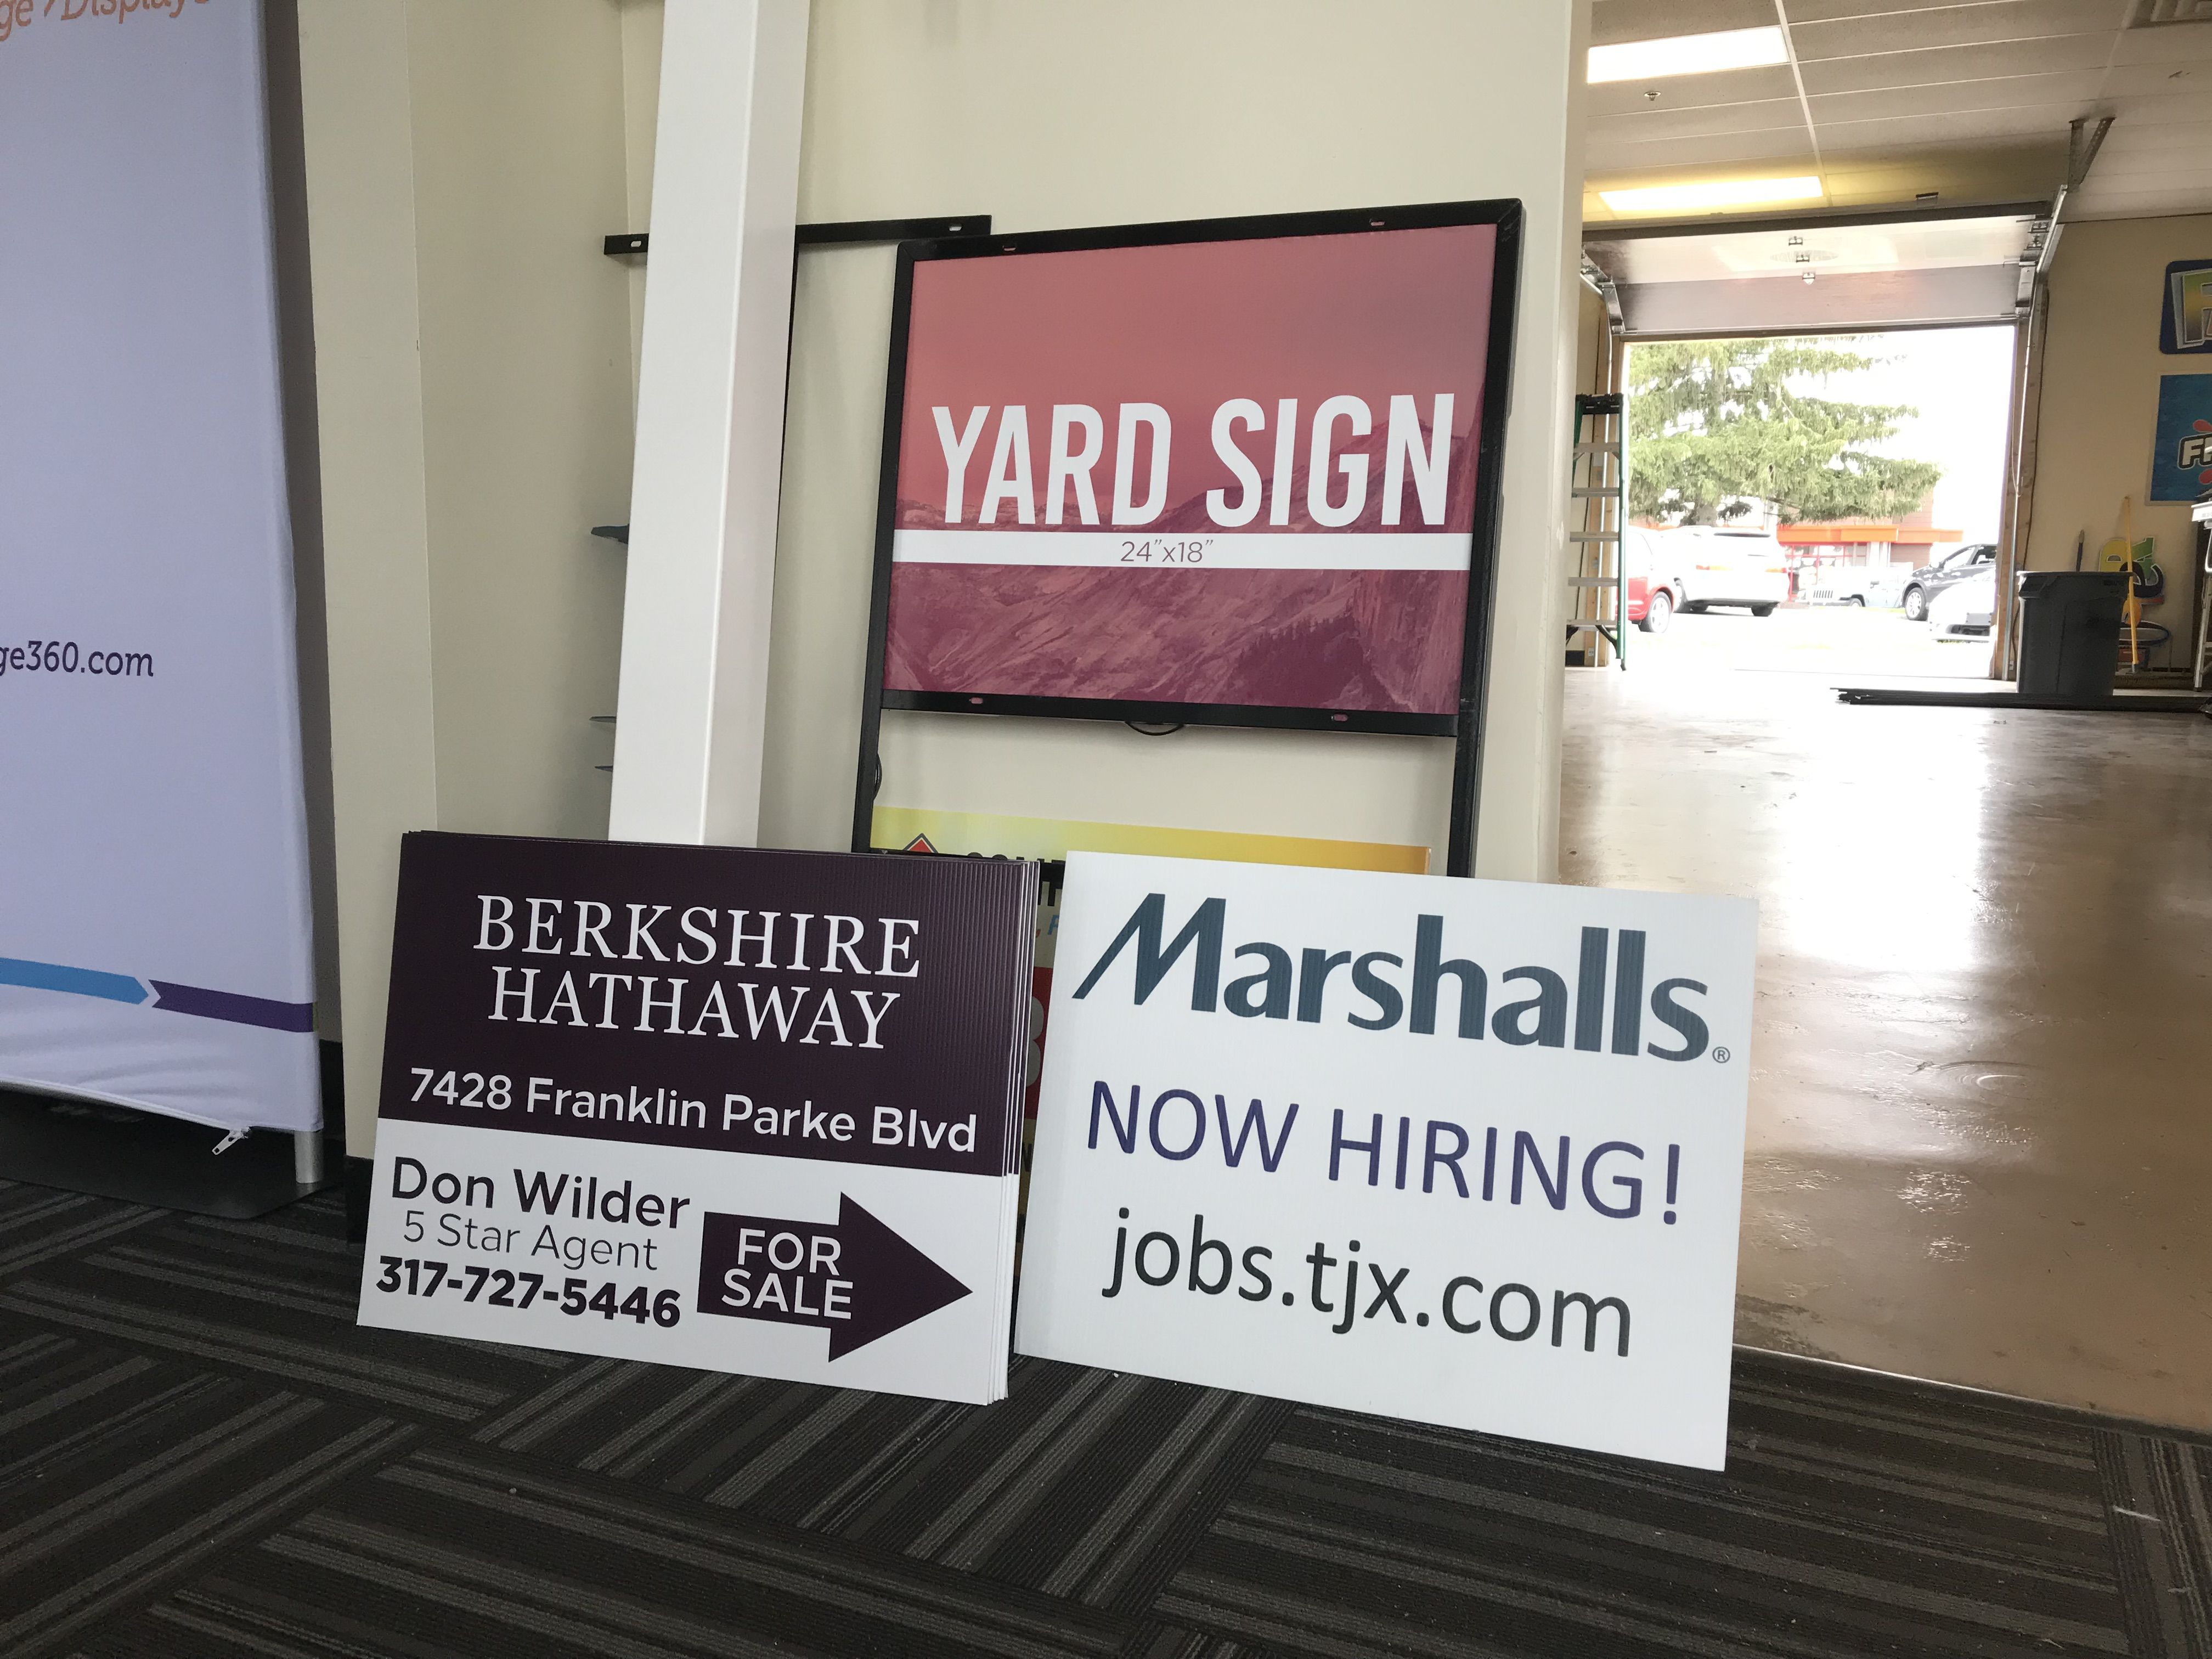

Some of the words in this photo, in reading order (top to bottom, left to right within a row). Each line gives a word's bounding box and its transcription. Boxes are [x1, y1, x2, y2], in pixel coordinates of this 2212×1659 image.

[932, 403, 1171, 525] YARD
[1206, 393, 1454, 527] SIGN
[473, 895, 920, 978] BERKSHIRE
[488, 966, 901, 1049] HATHAWAY
[410, 1068, 512, 1110] 7428
[527, 1077, 706, 1129] Franklin
[723, 1093, 856, 1142] Parke
[872, 1106, 977, 1153] Blvd
[392, 1156, 494, 1209] Don
[513, 1169, 691, 1229] Wilder
[1087, 1080, 1300, 1173] NOW
[1328, 1108, 1680, 1225] HIRING!
[403, 1210, 425, 1243] 5
[437, 1213, 521, 1254] Star
[531, 1224, 658, 1272] Agent
[737, 1228, 842, 1276] FOR
[1101, 1207, 1631, 1358] jobs.tjx.com
[376, 1255, 681, 1328] 317-727-5446
[721, 1268, 854, 1319] SALE
